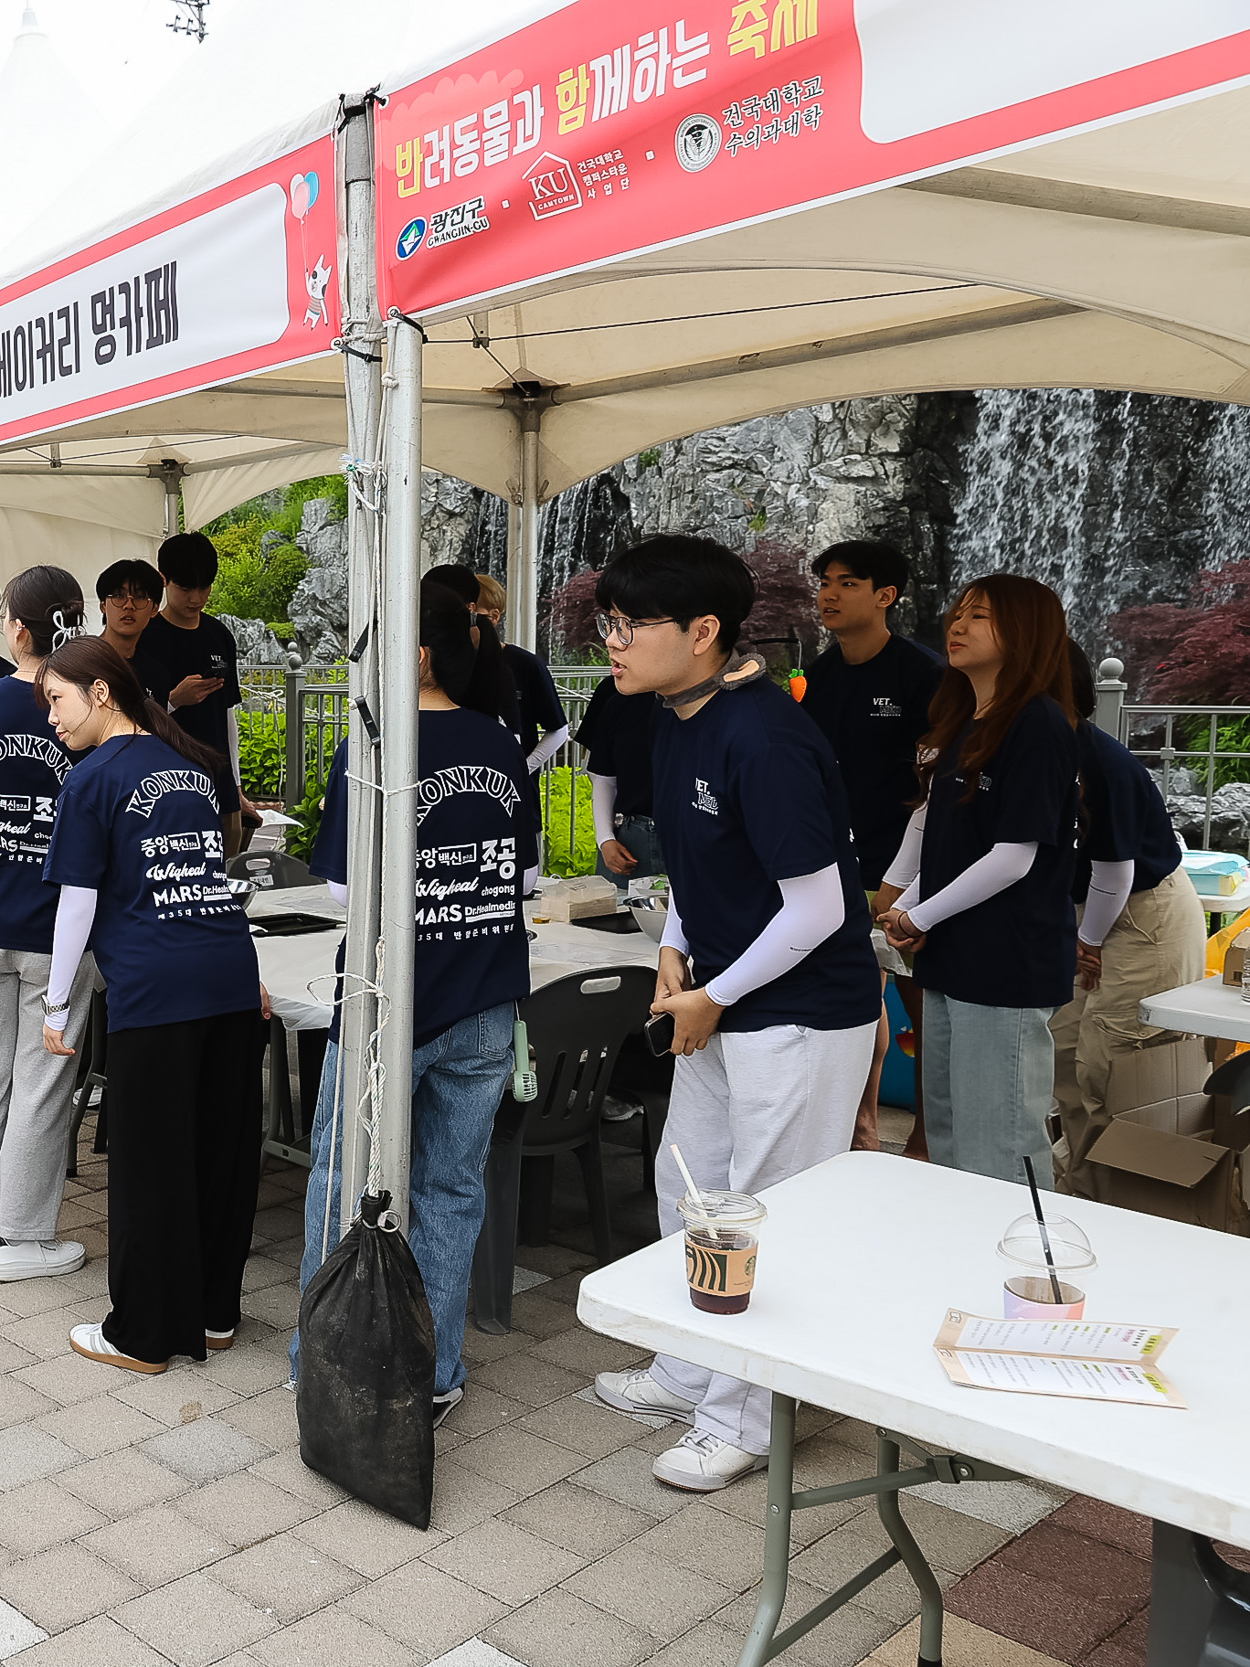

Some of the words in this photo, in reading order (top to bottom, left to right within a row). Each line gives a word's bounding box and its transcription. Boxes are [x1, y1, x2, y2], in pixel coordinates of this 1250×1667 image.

[395, 83, 544, 199] 반려동물과
[555, 15, 711, 136] 함께하는
[727, 0, 819, 58] 축제
[722, 75, 824, 128] 건국대학교
[724, 103, 823, 156] 수의과대학
[577, 150, 623, 173] 건국대학교
[582, 163, 628, 187] 캠퍼스타운
[528, 168, 569, 201] KU
[431, 198, 484, 234] 광진구
[537, 194, 575, 211] CAMTOWN
[427, 218, 489, 247] GWANGJIN-GU
[91, 260, 180, 366] 멍카페
[873, 697, 893, 706] VET.
[146, 862, 207, 882] Wigheal
[479, 837, 517, 881] 조공
[152, 884, 203, 908] MARS
[415, 876, 480, 901] Wigheal
[481, 884, 516, 898] chogong
